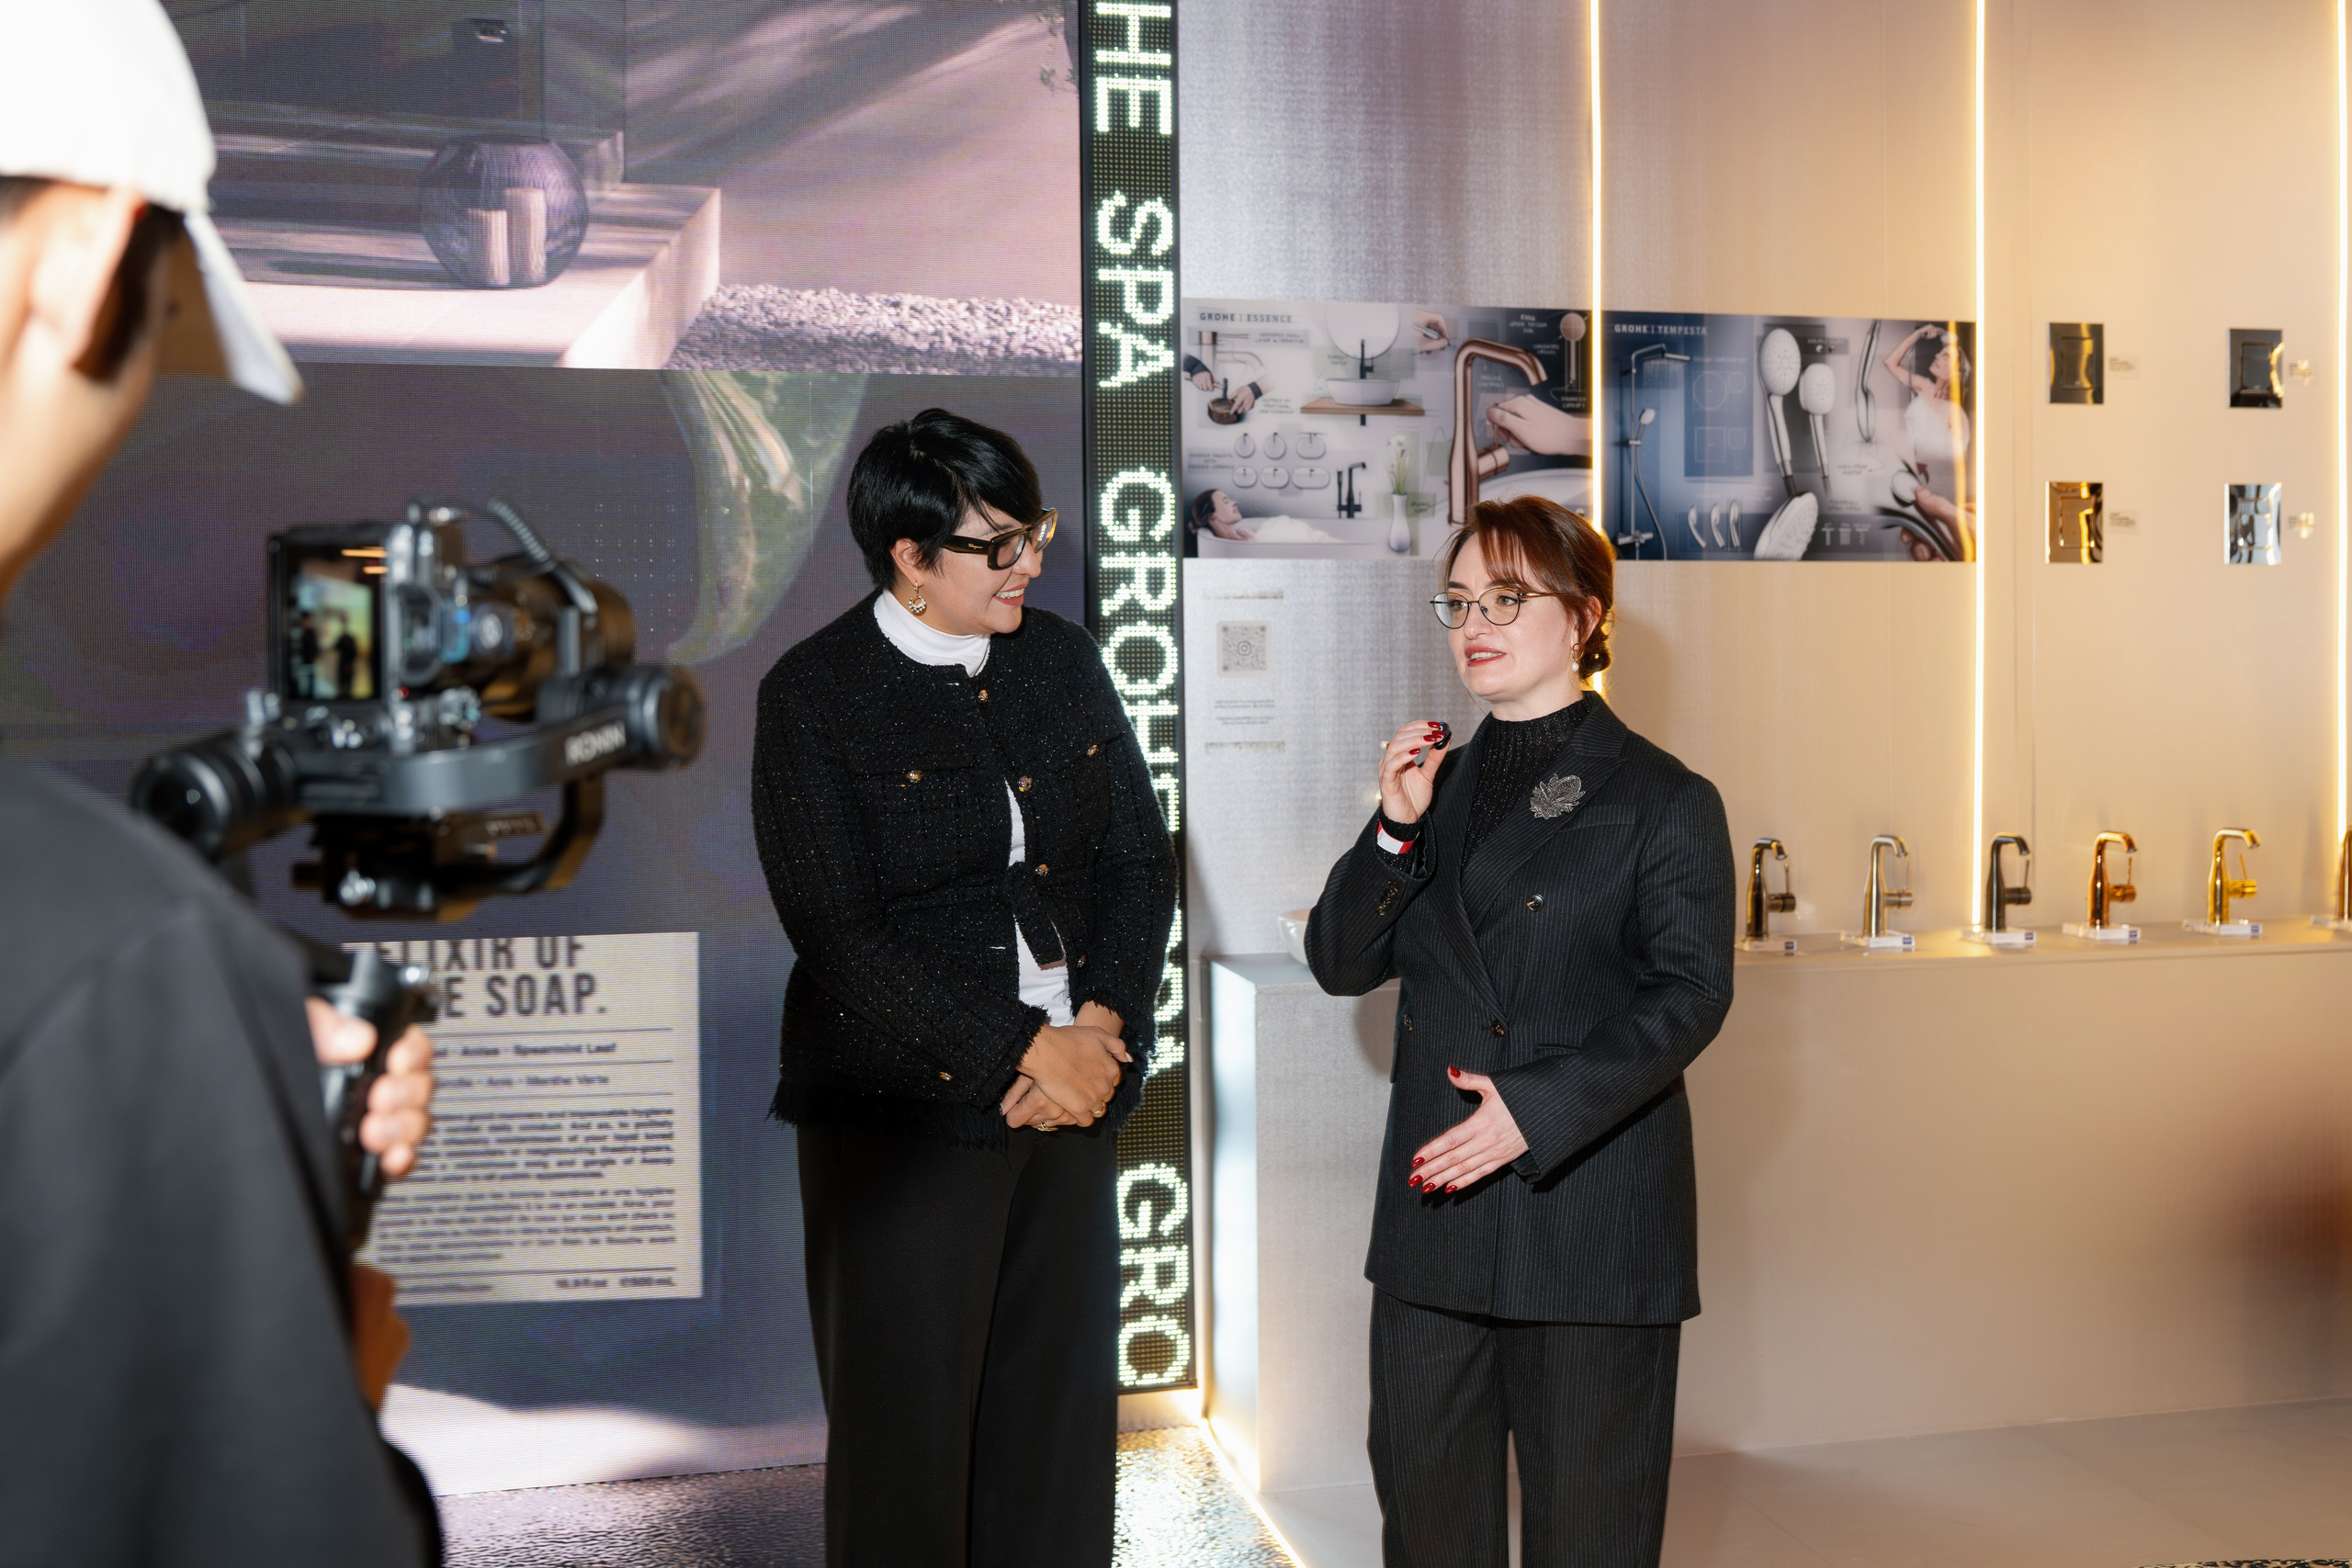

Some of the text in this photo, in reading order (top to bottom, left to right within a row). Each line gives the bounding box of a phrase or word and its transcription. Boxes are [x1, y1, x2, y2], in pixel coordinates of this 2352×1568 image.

[1097, 190, 1173, 387] SPA
[1199, 312, 1293, 323] GROHE ESSENCE
[1614, 323, 1708, 336] GROHE TEMPESTA
[485, 973, 607, 1017] SOAP.
[1116, 1163, 1190, 1386] GRO
